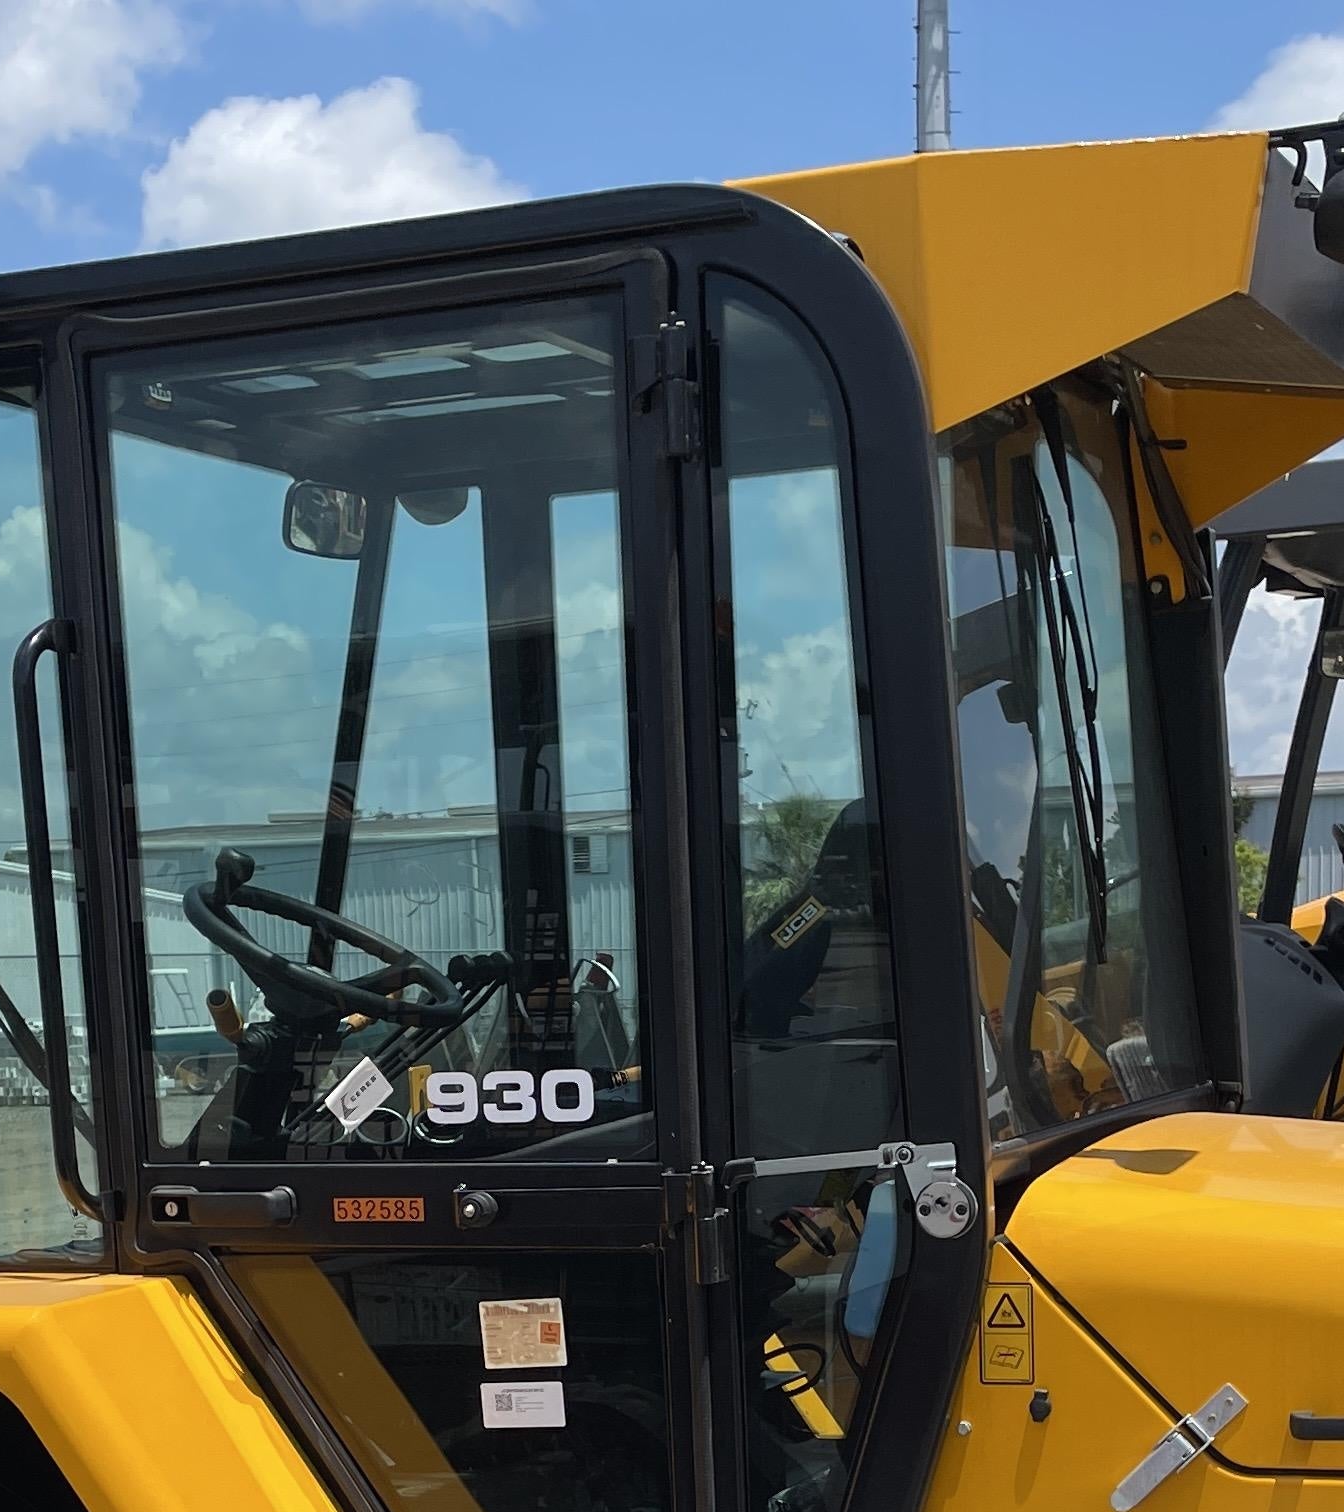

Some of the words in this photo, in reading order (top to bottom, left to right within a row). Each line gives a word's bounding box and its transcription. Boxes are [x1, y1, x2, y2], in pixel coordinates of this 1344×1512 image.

[782, 904, 818, 942] JCB
[426, 1069, 595, 1124] 930
[336, 1200, 420, 1220] 532585
